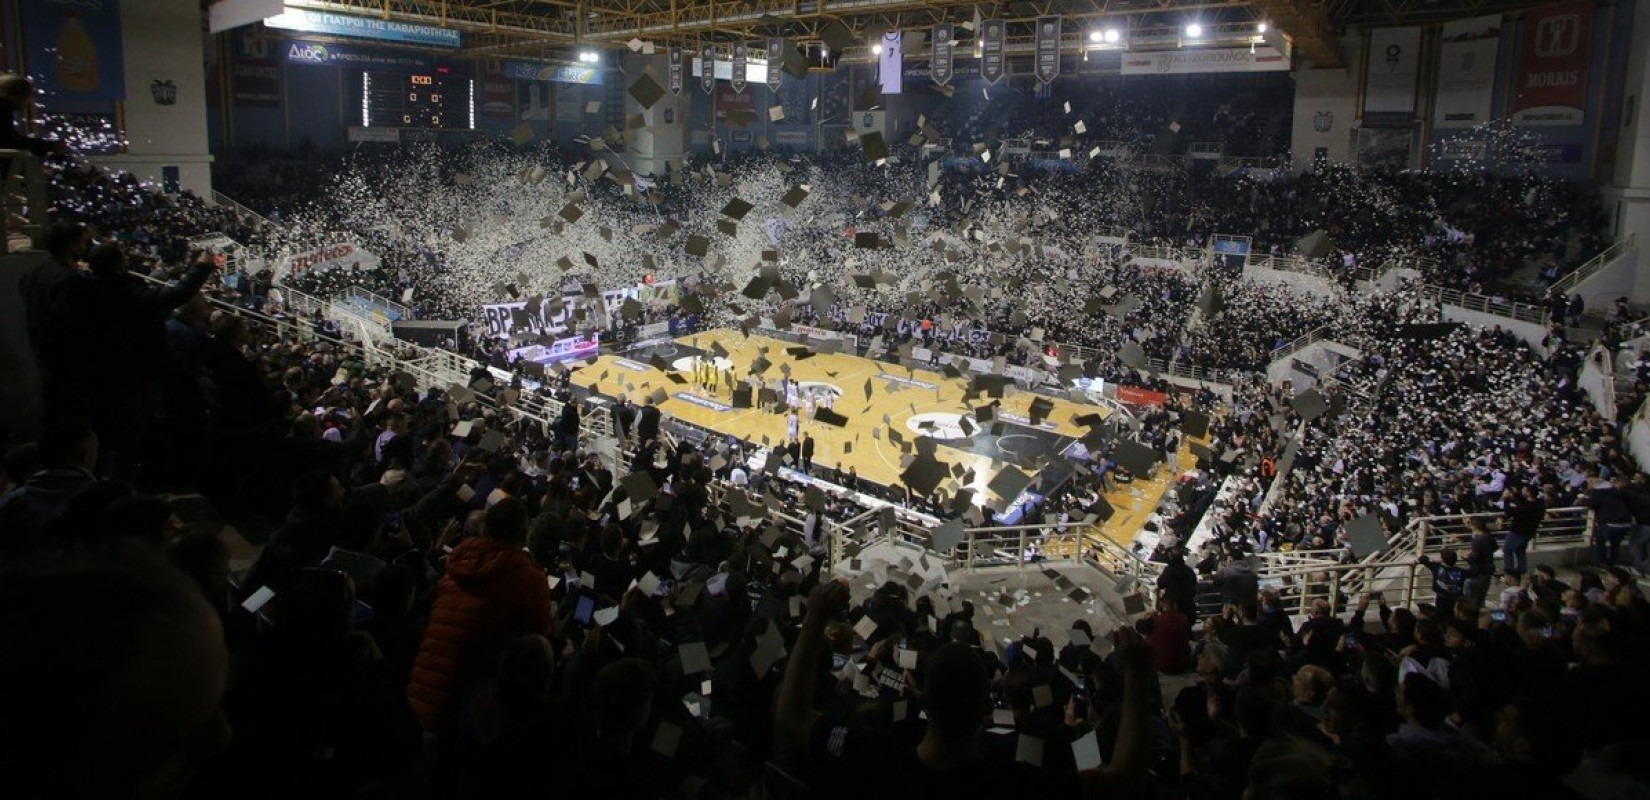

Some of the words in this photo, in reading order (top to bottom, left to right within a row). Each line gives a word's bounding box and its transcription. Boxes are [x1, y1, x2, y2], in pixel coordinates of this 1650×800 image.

[323, 14, 364, 28] ΓΙΑΤΡΟΙ
[367, 20, 387, 31] ΤΗΣ
[889, 47, 895, 58] 7
[1526, 70, 1579, 88] MORRIS
